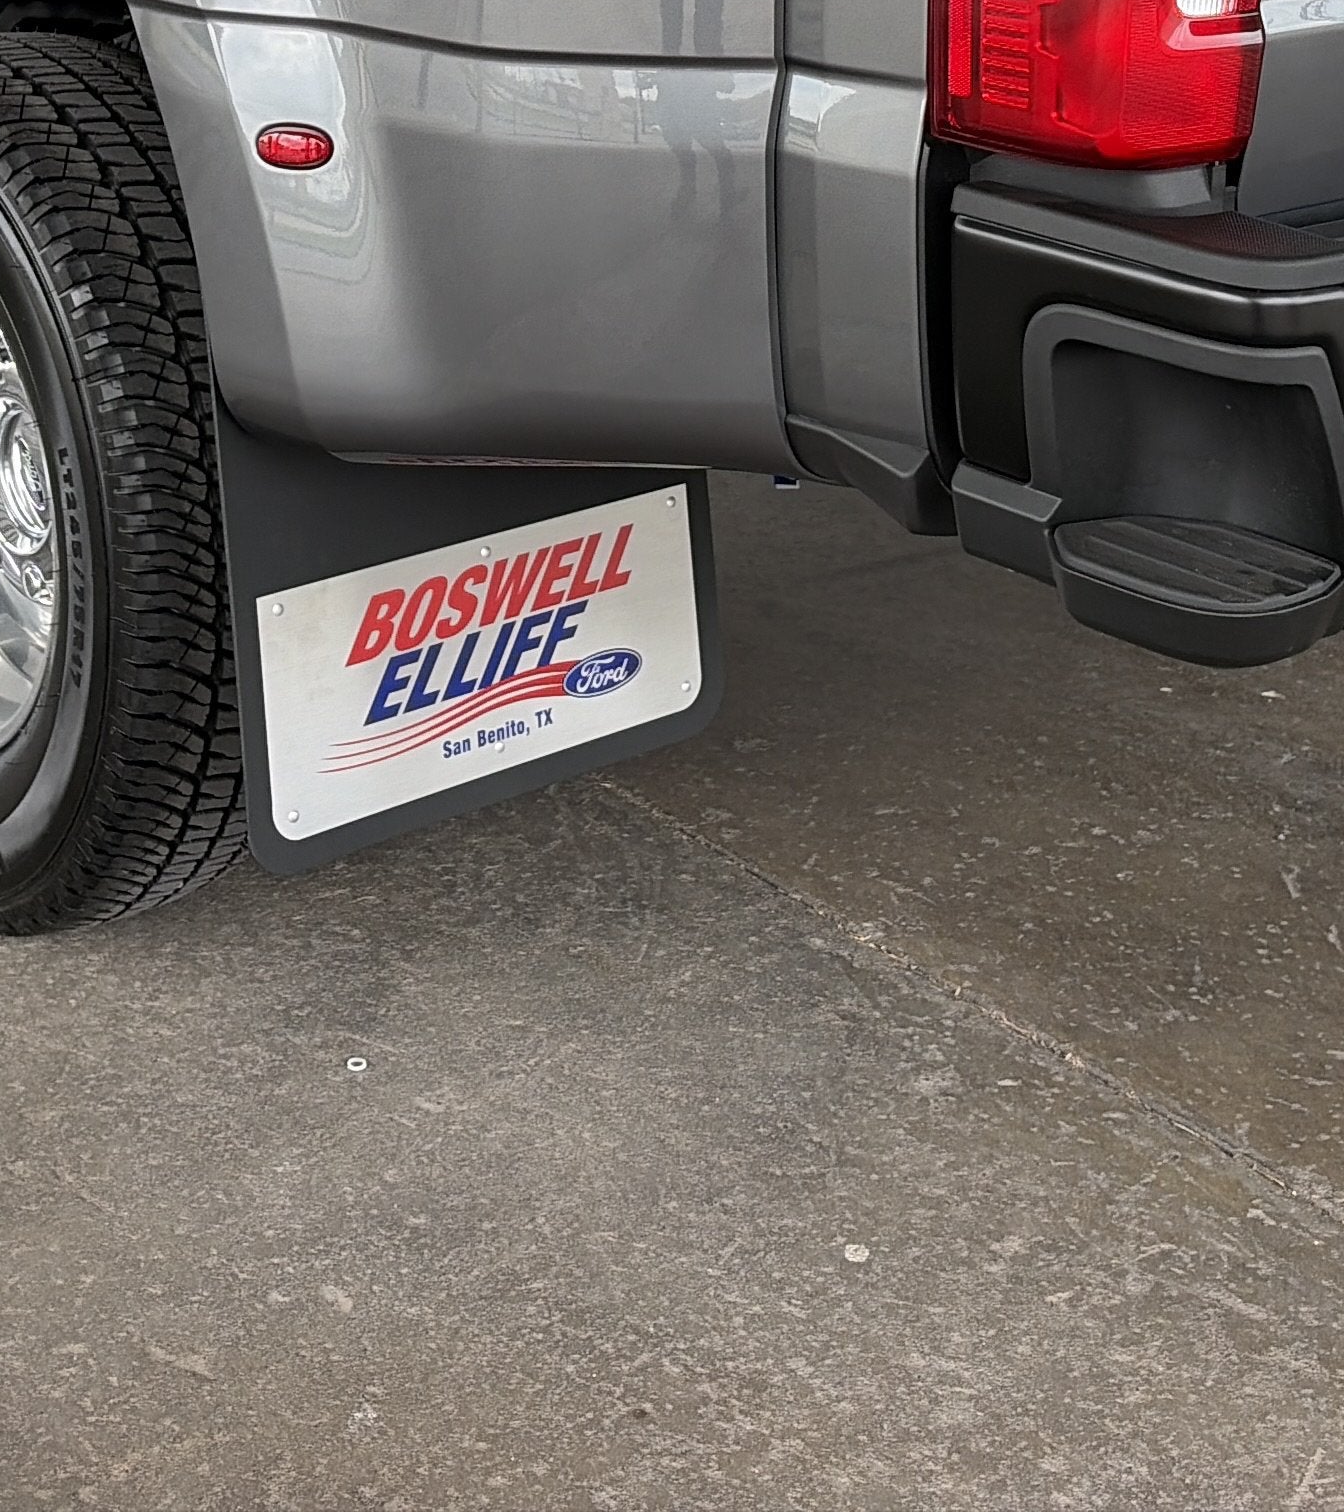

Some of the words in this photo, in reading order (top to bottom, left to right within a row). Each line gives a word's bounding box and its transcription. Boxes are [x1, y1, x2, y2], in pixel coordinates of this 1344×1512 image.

[345, 523, 633, 667] BOSWELL
[363, 601, 587, 725] ELLIFF
[443, 739, 471, 758] San
[477, 720, 530, 748] Benito,
[535, 707, 553, 729] TX
